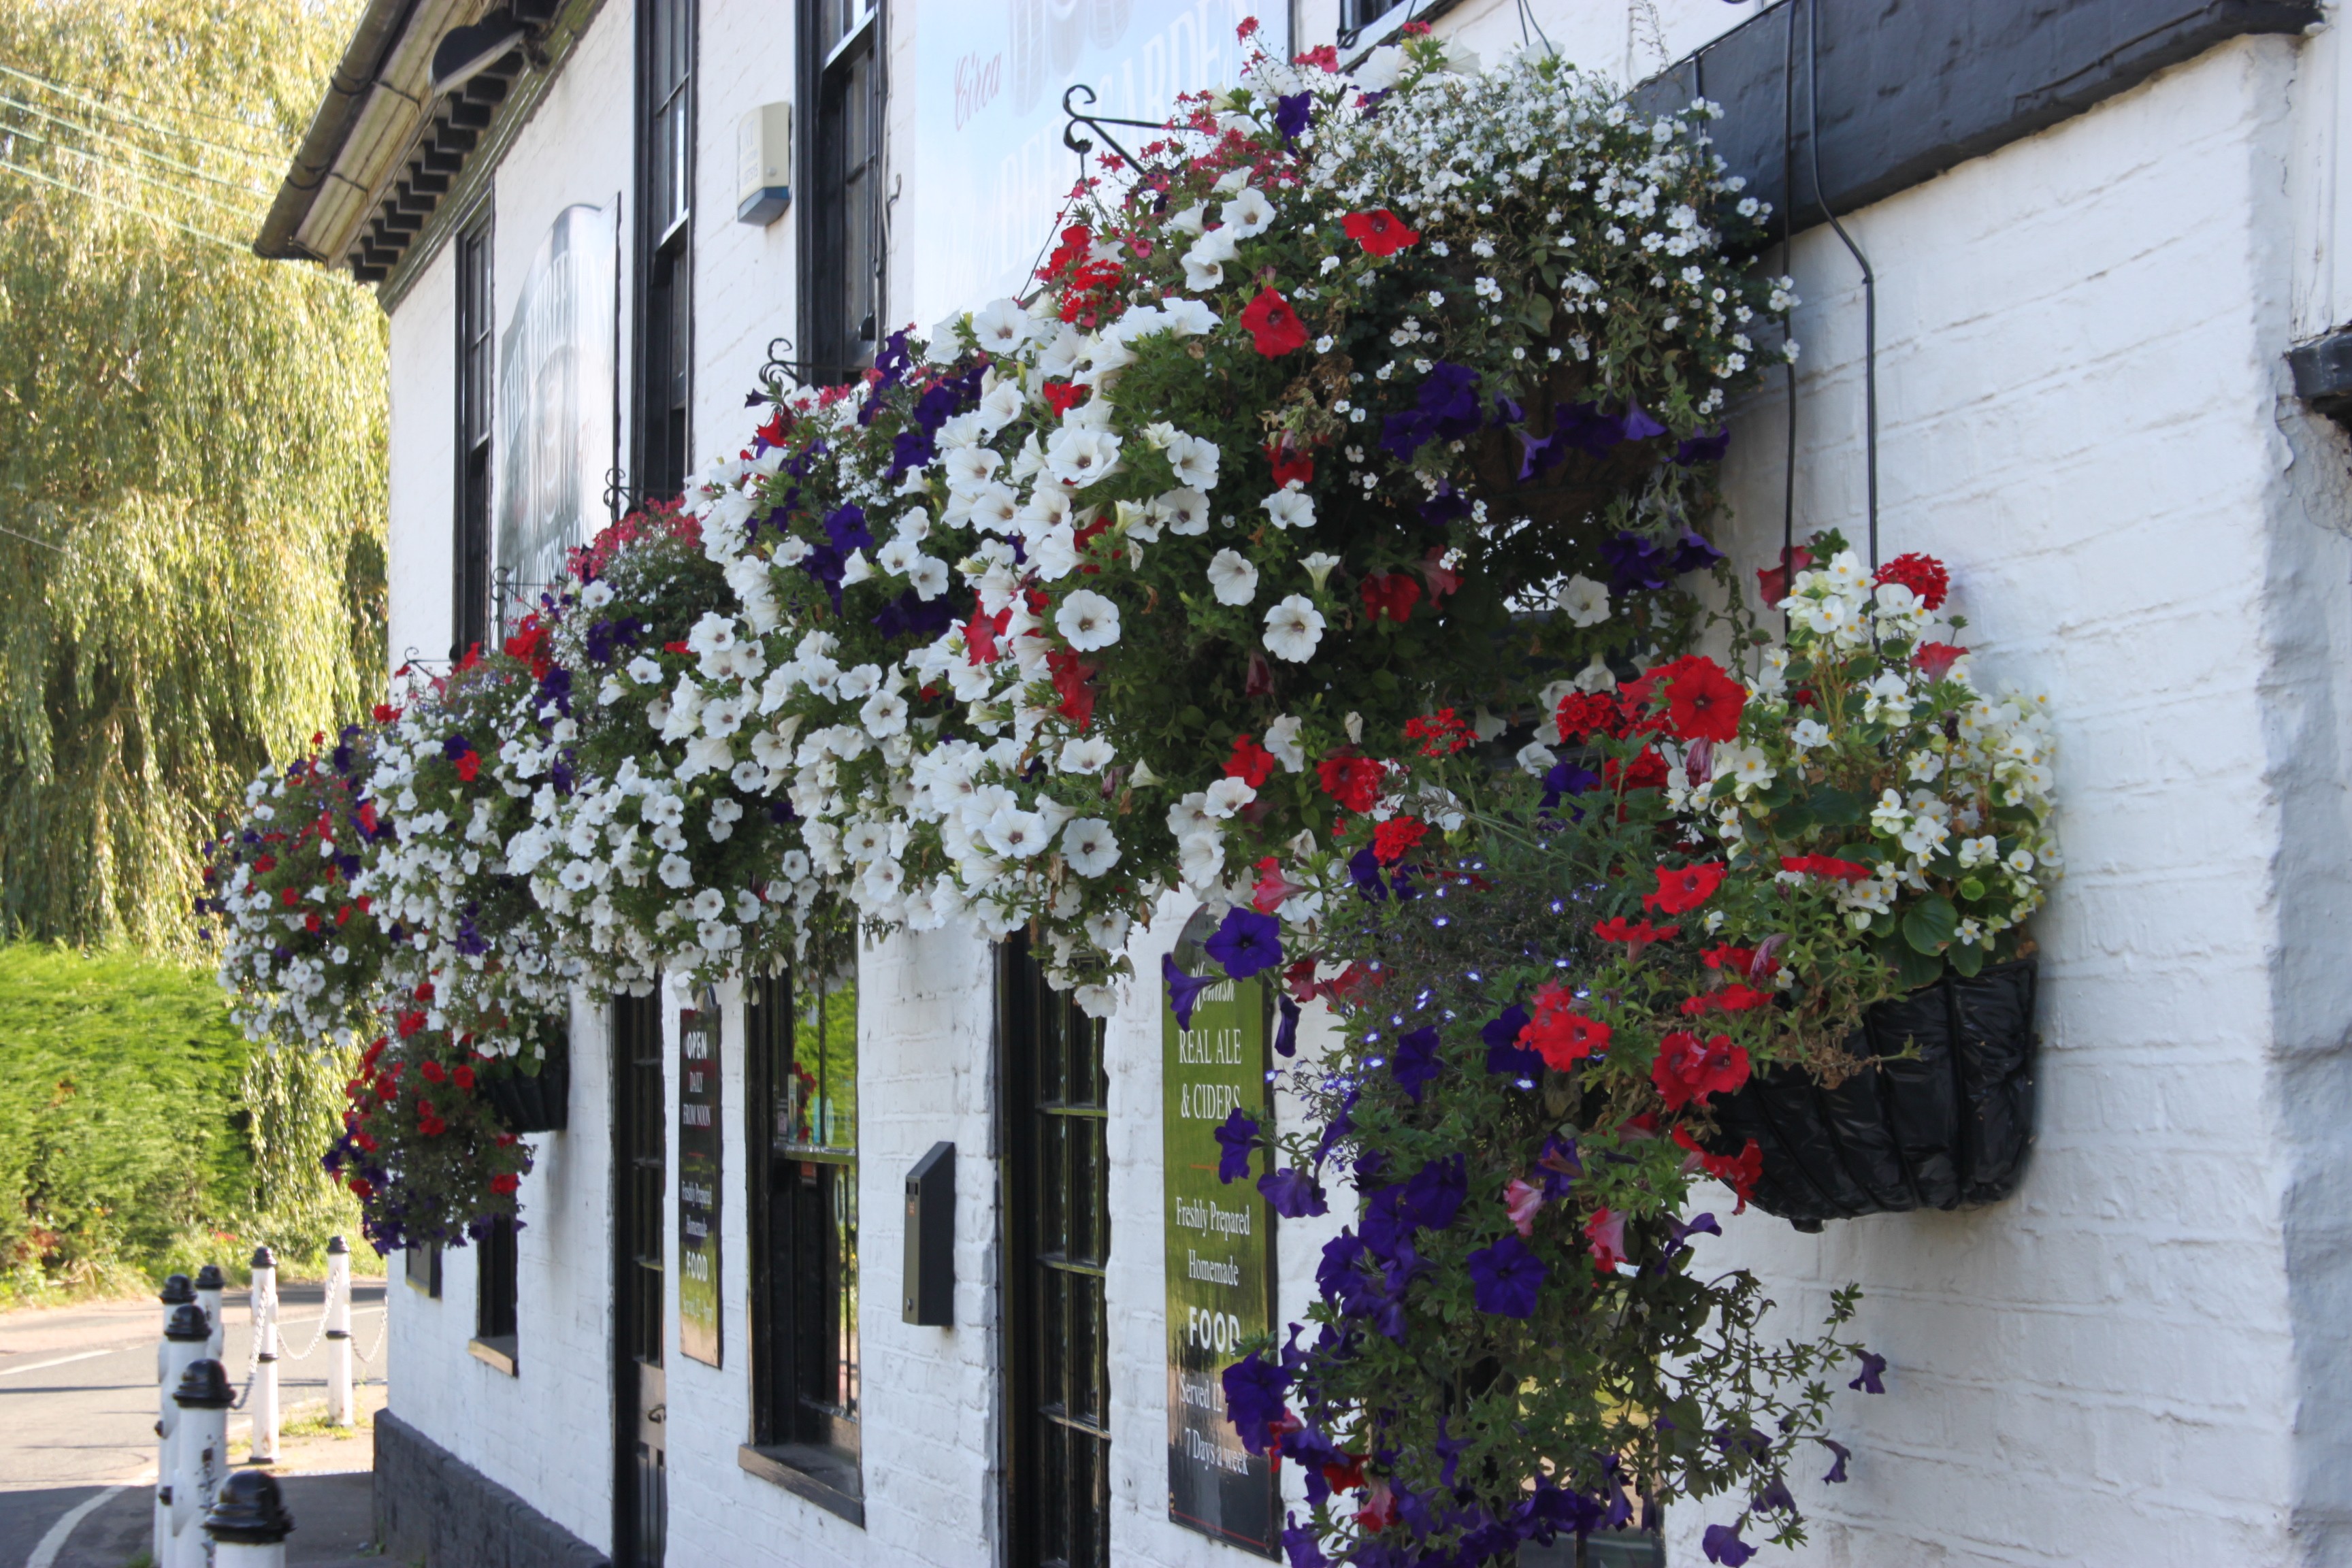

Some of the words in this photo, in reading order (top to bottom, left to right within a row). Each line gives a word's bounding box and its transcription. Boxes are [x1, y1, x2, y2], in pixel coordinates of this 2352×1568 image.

[954, 50, 1002, 132] Circa
[502, 325, 525, 465] THE
[526, 250, 568, 398] THREE
[687, 1031, 707, 1060] OPEN
[1179, 1029, 1212, 1064] REAL
[1215, 1029, 1241, 1064] ALE
[689, 1071, 704, 1093] DAILY
[683, 1102, 696, 1126] FROM
[696, 1104, 710, 1128] NOON
[1181, 1083, 1190, 1118] &
[1194, 1084, 1241, 1120] CIDERS
[1176, 1196, 1208, 1237] Freshly
[1210, 1200, 1250, 1241] Prepared
[687, 1251, 708, 1283] FOOD
[1188, 1248, 1239, 1286] Homemade
[1188, 1305, 1241, 1356] FOOD
[1179, 1373, 1210, 1409] Served
[1213, 1382, 1223, 1412] 12
[1185, 1426, 1191, 1458] 7
[1192, 1428, 1215, 1470] Days
[1217, 1446, 1222, 1467] a
[1224, 1443, 1249, 1475] week
